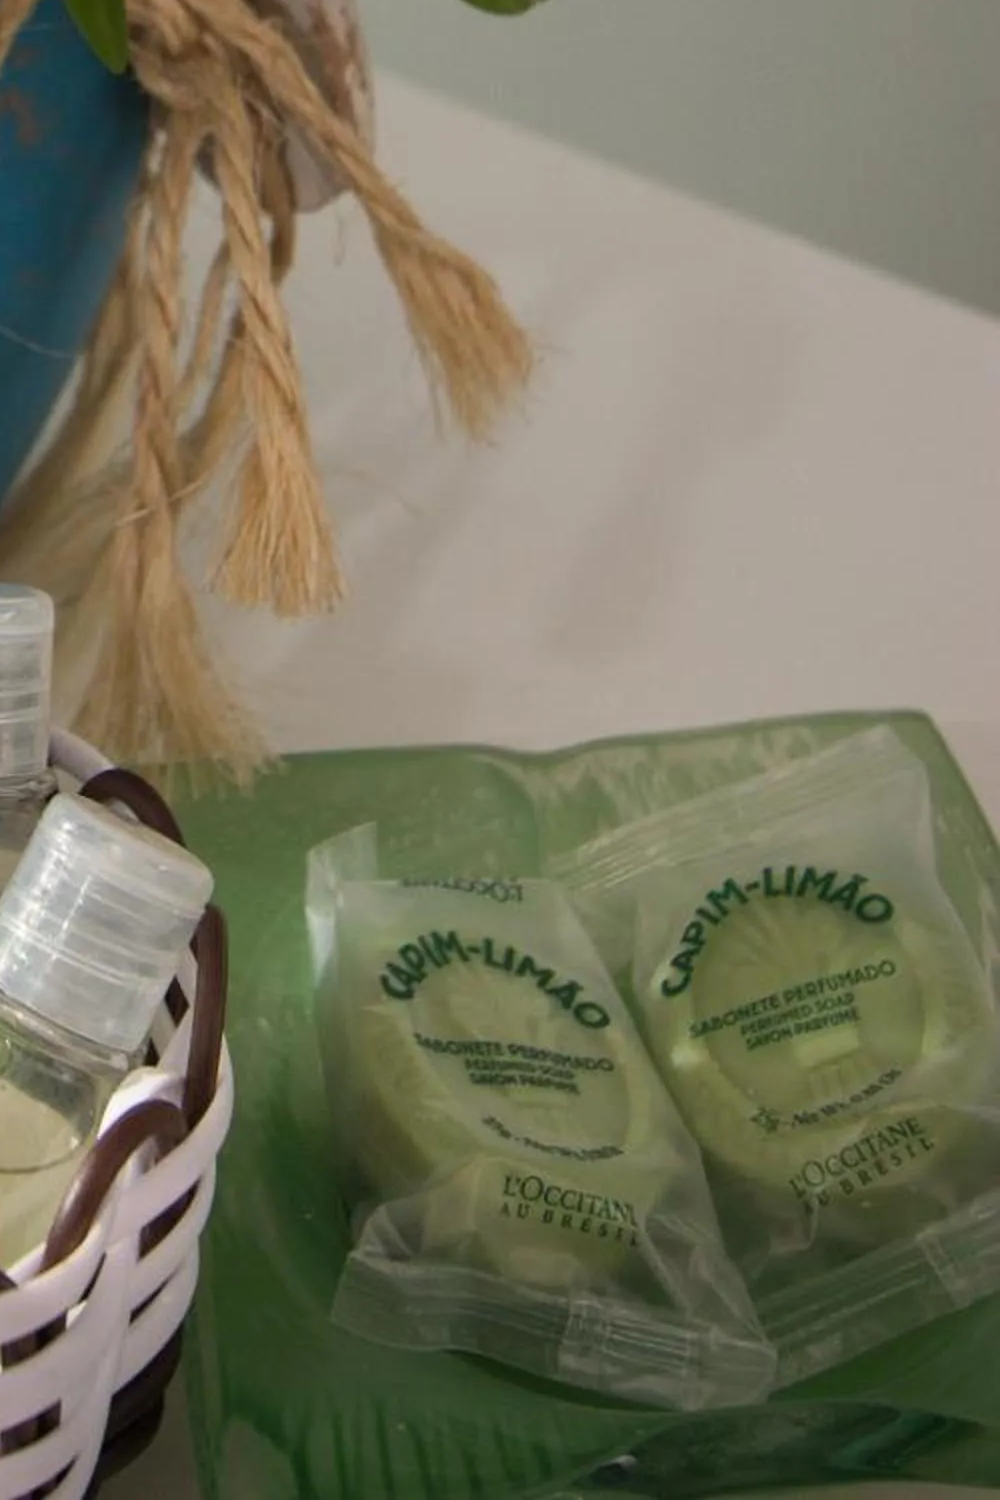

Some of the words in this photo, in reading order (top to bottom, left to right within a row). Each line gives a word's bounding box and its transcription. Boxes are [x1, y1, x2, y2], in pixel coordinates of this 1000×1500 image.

[660, 865, 895, 999] CAPIM-LIMÃO
[379, 929, 611, 1030] CAPIM-LIMÃO
[688, 993, 781, 1039] SABONETE
[783, 958, 897, 1012] PERFUMADO
[787, 1115, 925, 1199] L'OCCITANE
[502, 1174, 638, 1227] L'OCCITAN
